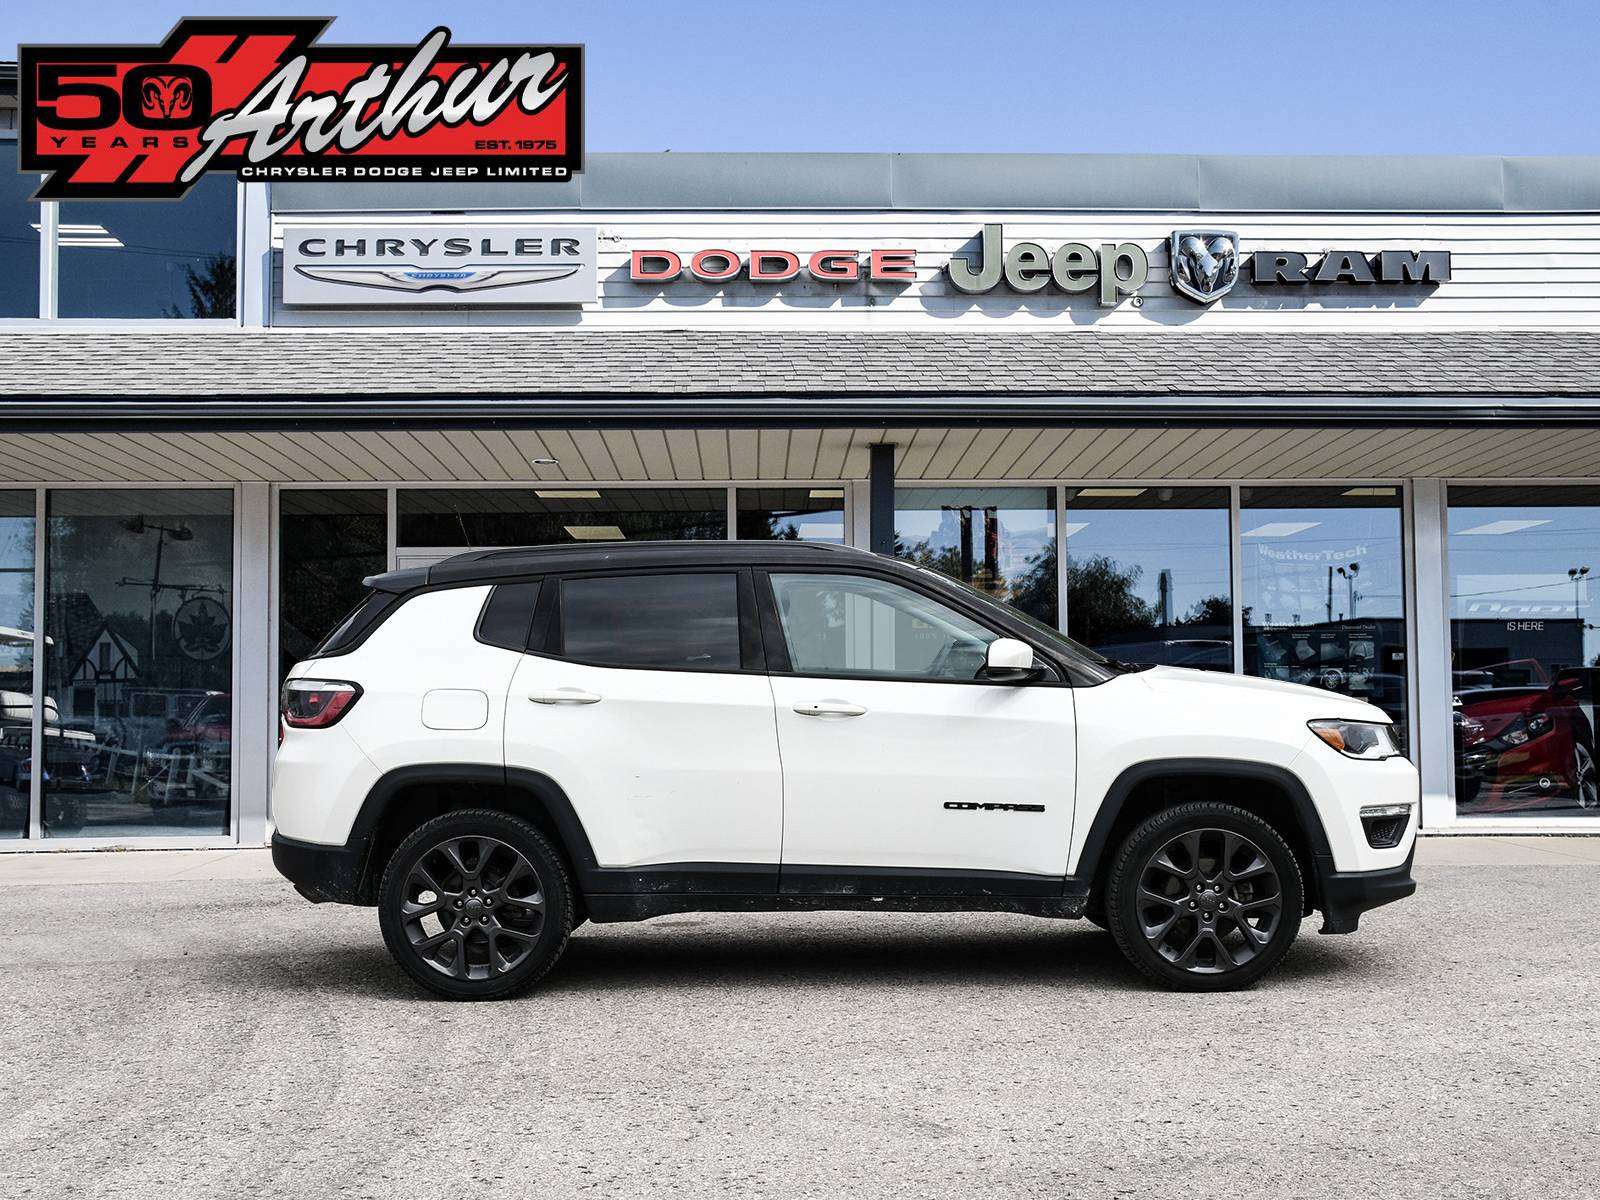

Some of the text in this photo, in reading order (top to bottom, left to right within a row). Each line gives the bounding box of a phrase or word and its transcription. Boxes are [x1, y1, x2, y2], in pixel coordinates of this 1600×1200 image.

[298, 238, 580, 256] CHRYSLER
[630, 249, 918, 282] DODGE
[949, 223, 1149, 307] Jeep
[1252, 251, 1452, 284] RAM
[1258, 543, 1368, 560] WeatherTech
[1506, 621, 1545, 631] IS HERE
